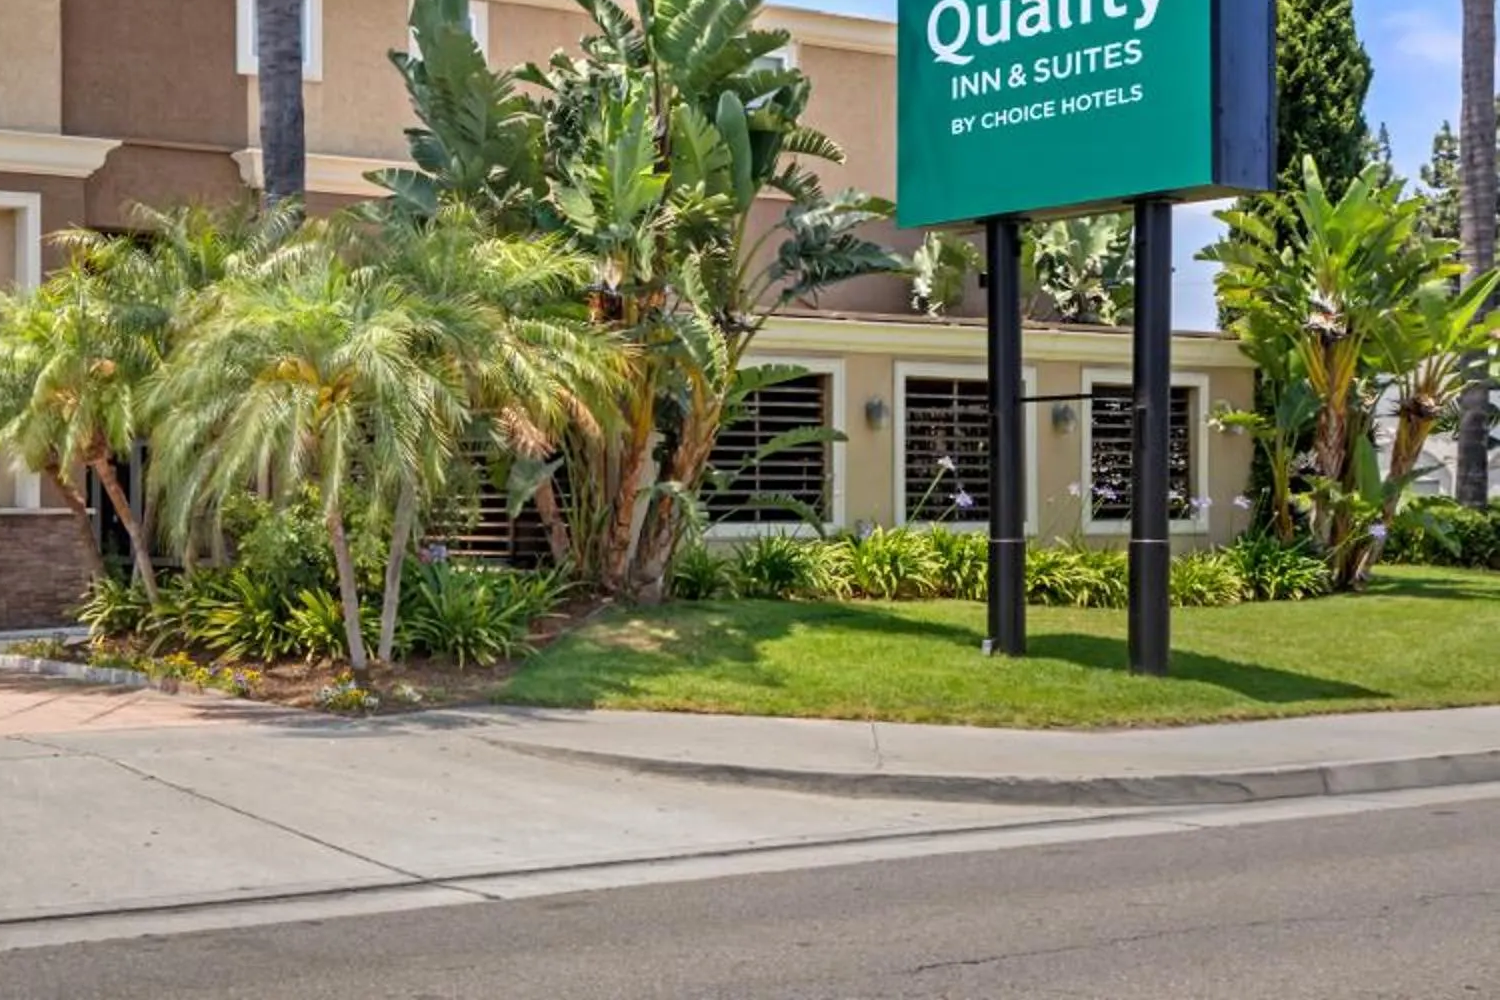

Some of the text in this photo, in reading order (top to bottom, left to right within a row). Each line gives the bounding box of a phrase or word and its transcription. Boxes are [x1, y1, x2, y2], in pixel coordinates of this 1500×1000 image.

[951, 39, 1144, 100] INN & SUITES
[951, 84, 1144, 135] BY CHOICE HOTELS
